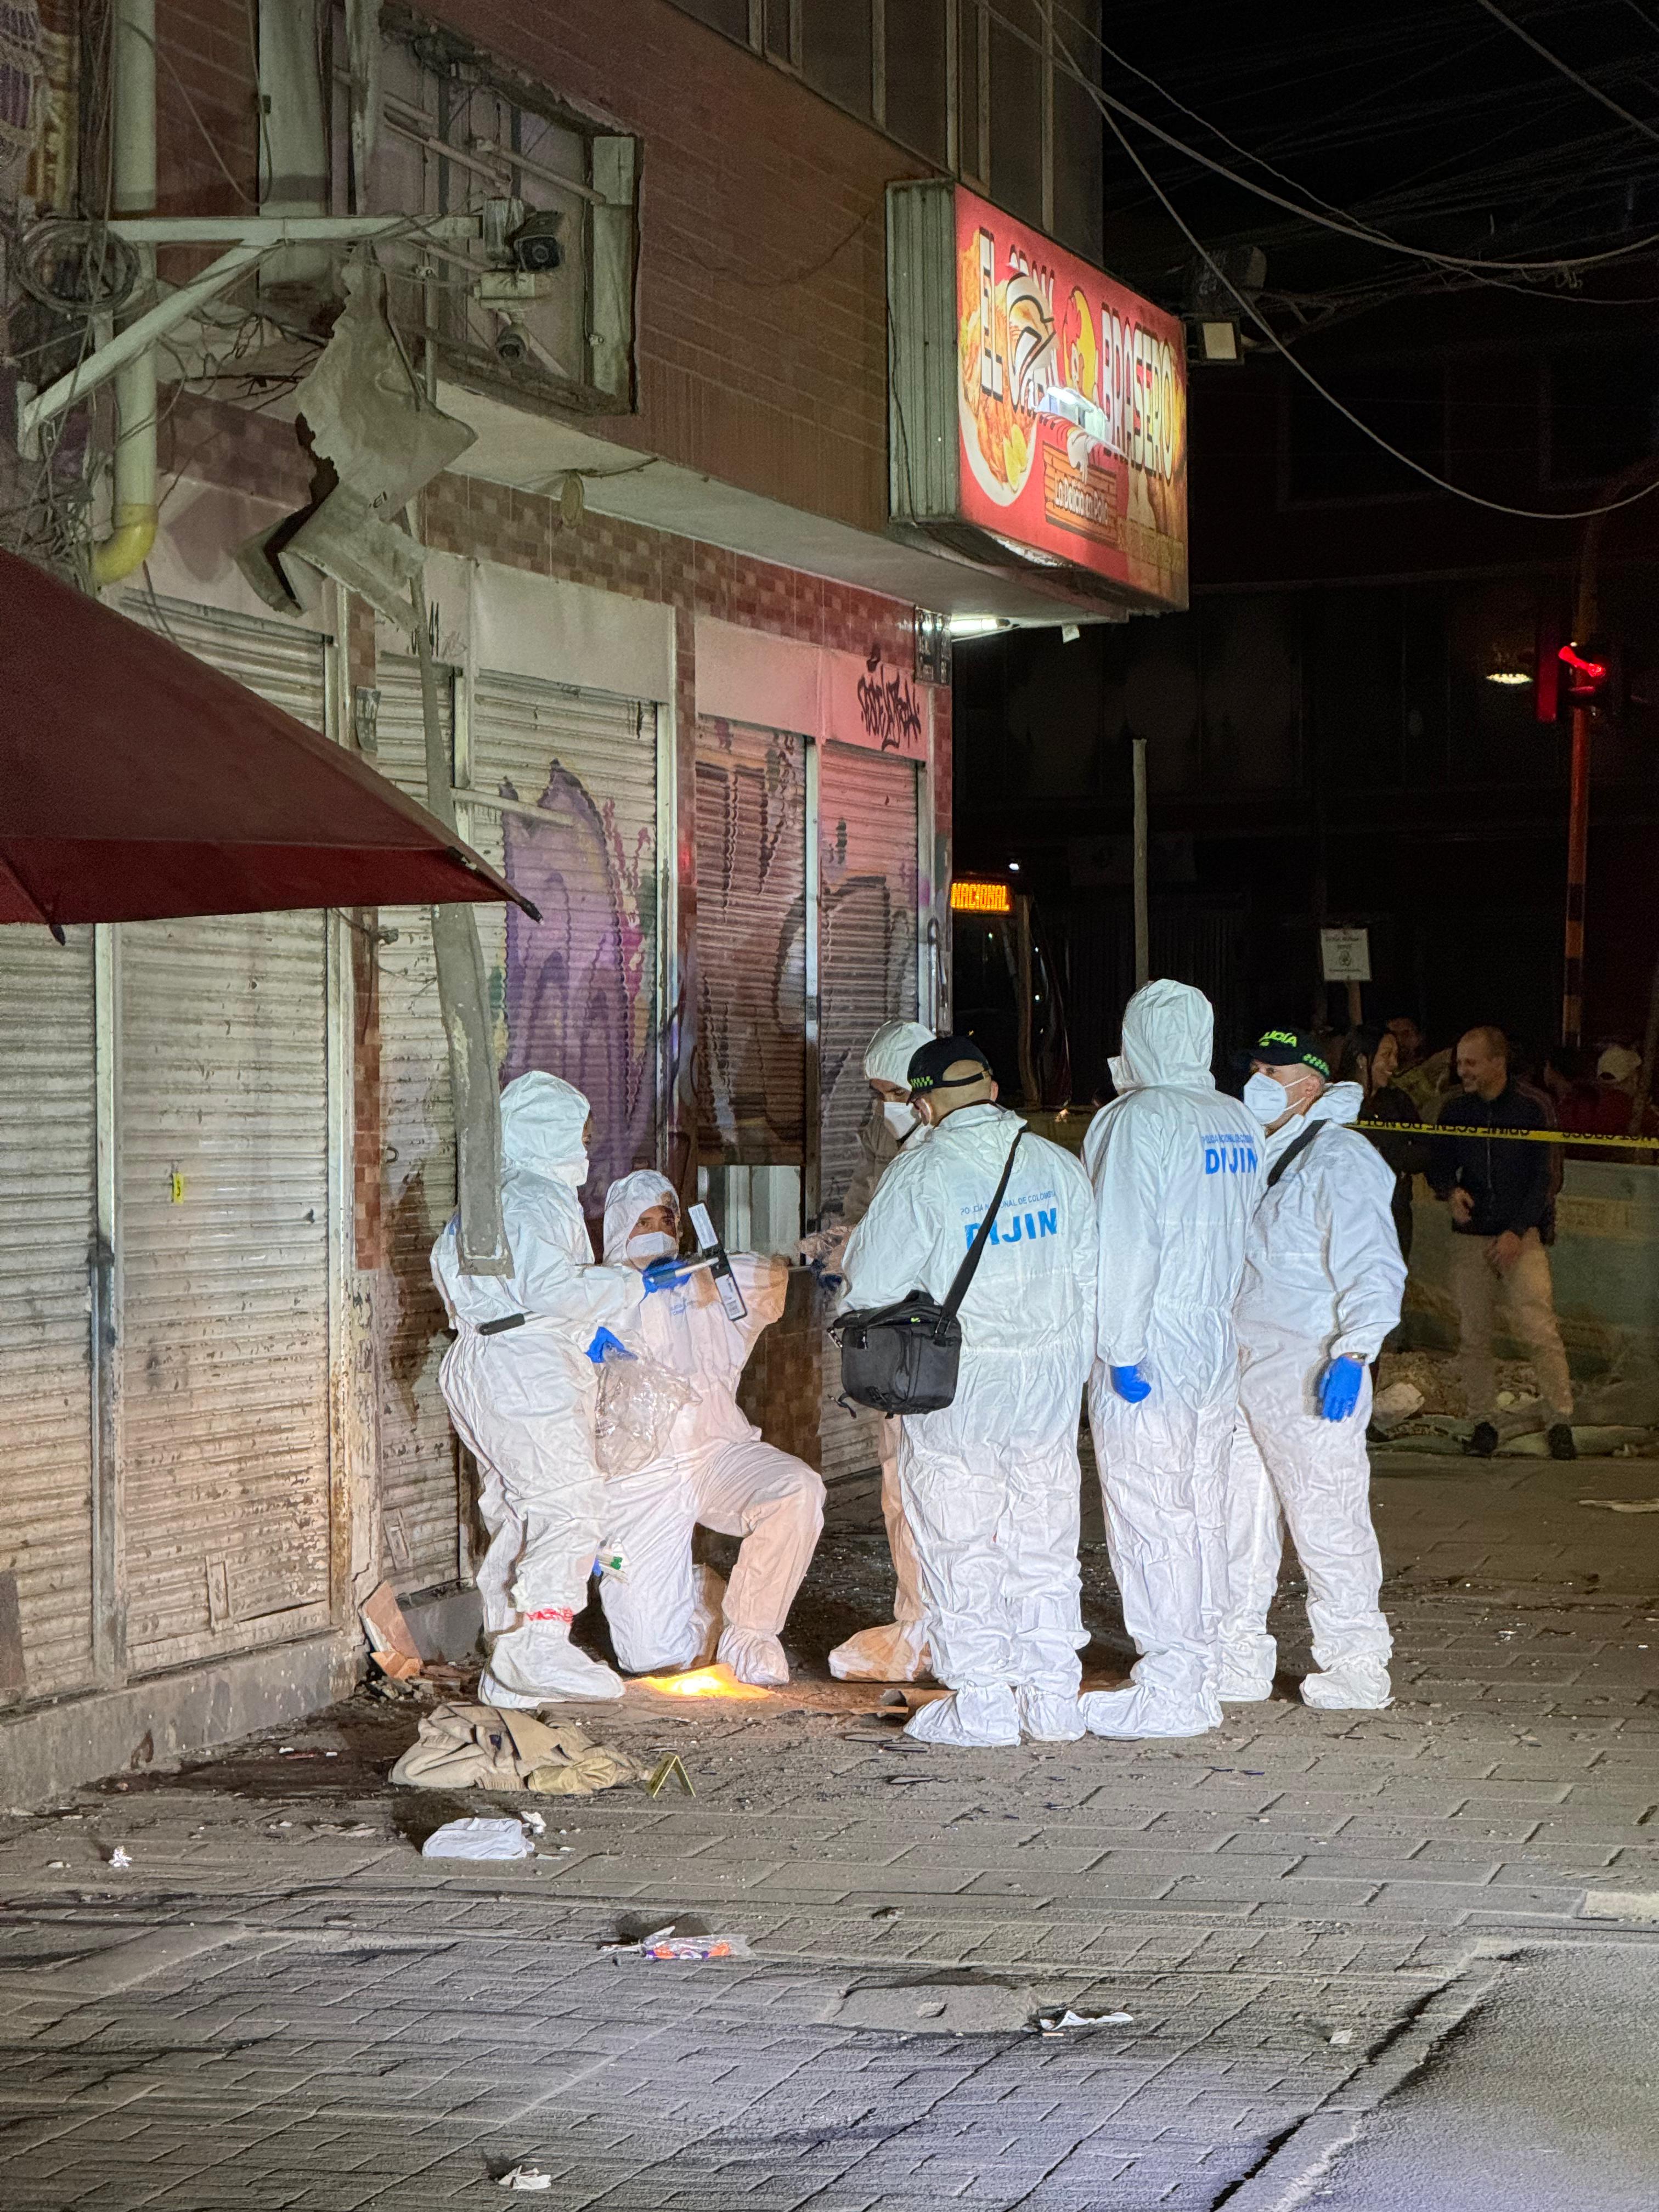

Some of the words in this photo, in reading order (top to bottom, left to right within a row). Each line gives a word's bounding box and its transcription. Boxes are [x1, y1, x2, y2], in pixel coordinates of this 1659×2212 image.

[979, 226, 1003, 403] EL
[1101, 302, 1175, 487] BRASERO
[951, 883, 1009, 910] NACIONAL
[1204, 1147, 1258, 1175] DIJIN
[1018, 1197, 1028, 1205] DE
